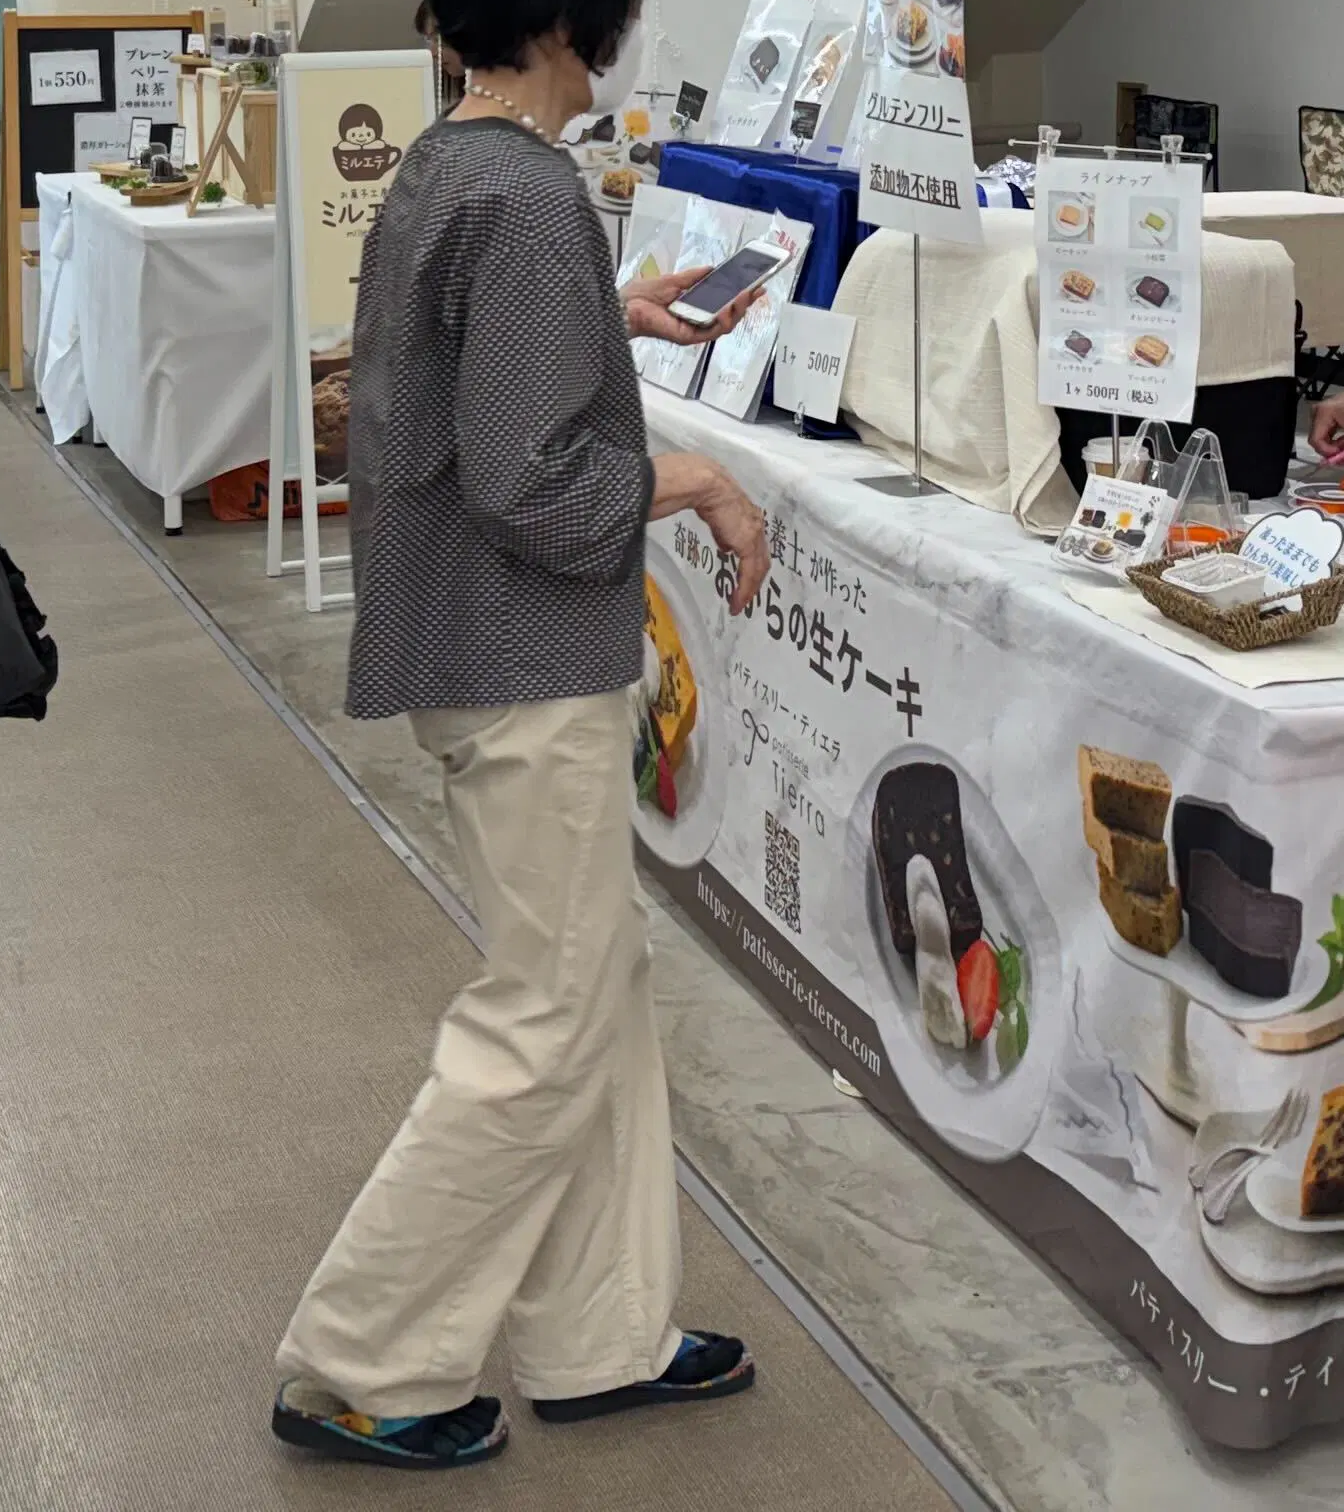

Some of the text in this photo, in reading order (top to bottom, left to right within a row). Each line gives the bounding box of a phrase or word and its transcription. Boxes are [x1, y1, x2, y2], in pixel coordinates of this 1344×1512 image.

[125, 48, 173, 61] プレーン
[131, 65, 169, 78] ベリー
[136, 83, 165, 96] 抹茶
[867, 92, 961, 131] グルテンフリー
[341, 156, 384, 170] ミルエテ
[870, 163, 959, 206] 添加物不使用
[1080, 172, 1152, 187] ラインナップ
[1086, 385, 1120, 401] 500円
[674, 520, 923, 738] 奇跡のおらの生ケーキ
[772, 760, 825, 838] Tierra
[697, 871, 882, 1077] https://patisserie-tierra.com
